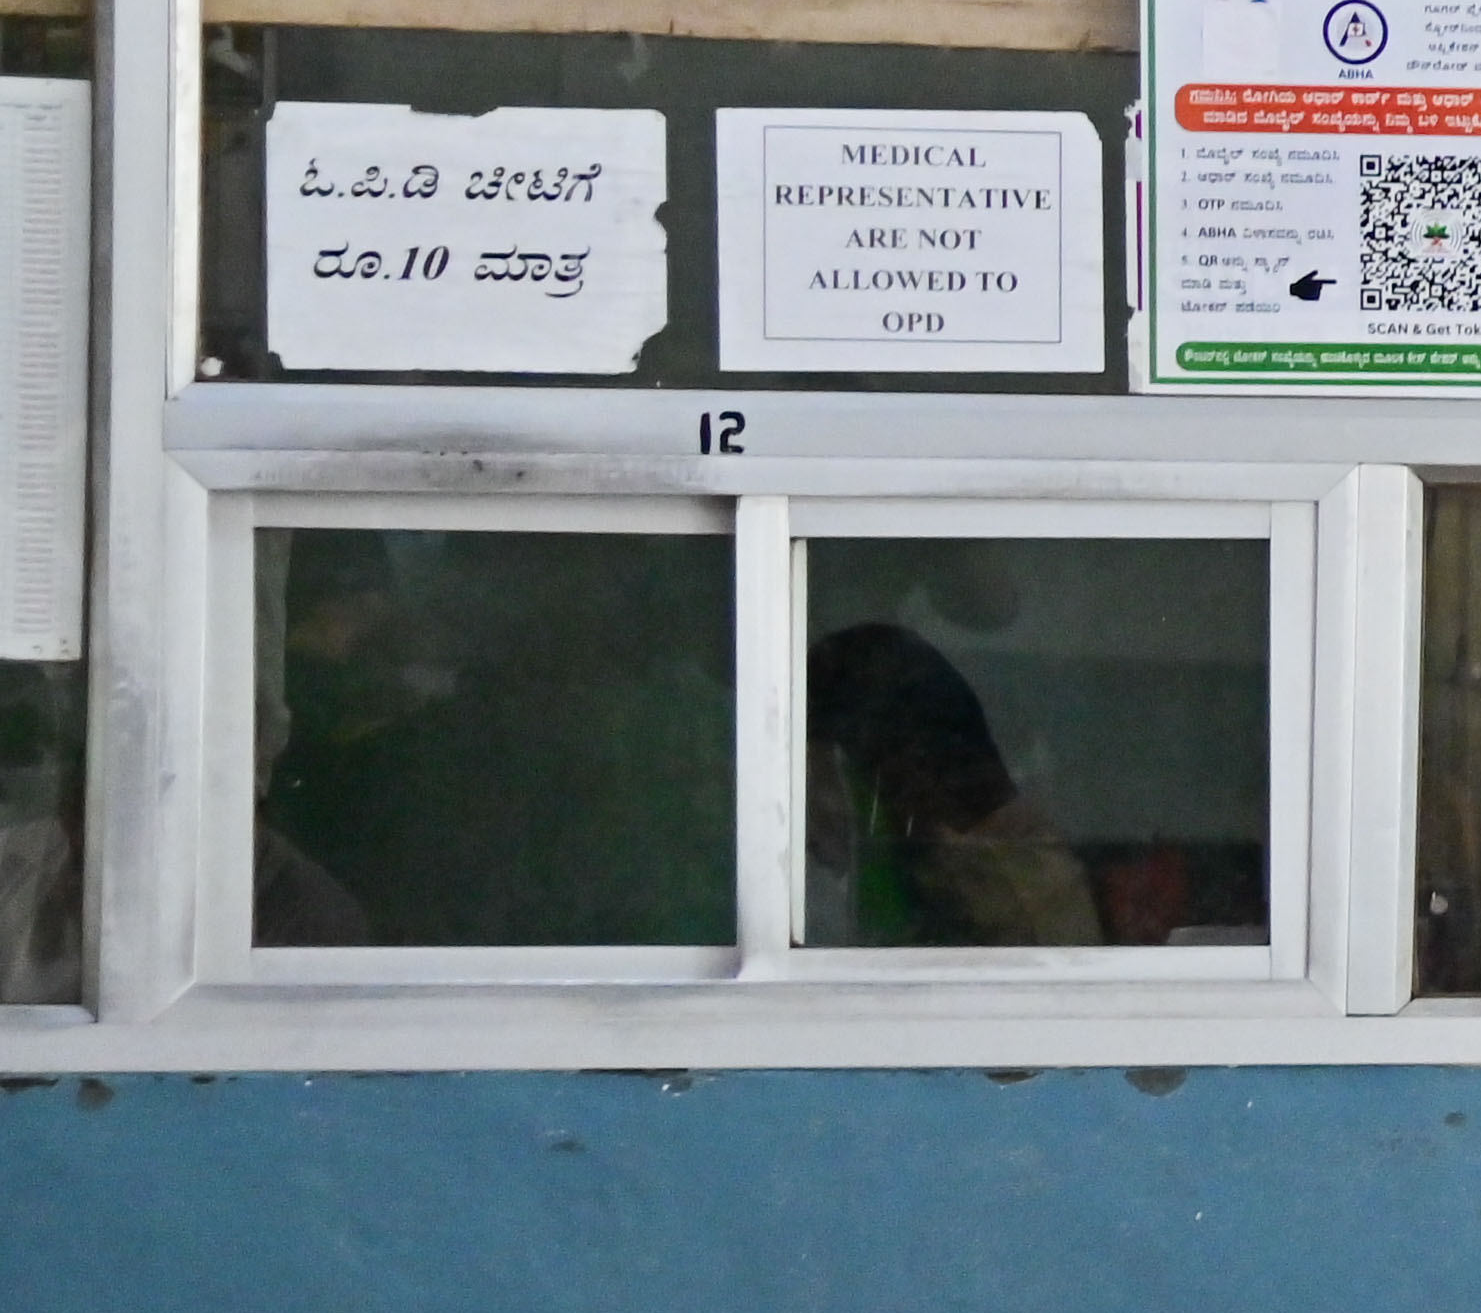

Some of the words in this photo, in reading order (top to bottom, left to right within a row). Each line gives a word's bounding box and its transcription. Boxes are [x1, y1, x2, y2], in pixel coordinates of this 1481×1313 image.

[1338, 68, 1374, 80] ABHA
[840, 143, 989, 170] MEDICAL
[298, 161, 441, 203] ಓ.ಪಿ.ಡಿ
[462, 160, 603, 207] ಚೀಟಿಗೆ
[772, 182, 1054, 213] REPRESENTATIVE
[1198, 198, 1225, 211] OTP
[843, 226, 903, 254] ARE
[911, 226, 984, 253] NOT
[1198, 227, 1237, 239] ABHA
[312, 243, 450, 283] ರೂ.10
[471, 244, 592, 300] ಮಾತ್ರ
[1198, 254, 1217, 267] QR
[808, 267, 966, 295] ALLOWED
[972, 269, 1019, 296] TO
[880, 309, 946, 336] OPD
[1368, 323, 1408, 335] SCAN
[1413, 324, 1422, 335] &
[1426, 324, 1451, 336] Get
[698, 410, 748, 455] 12
